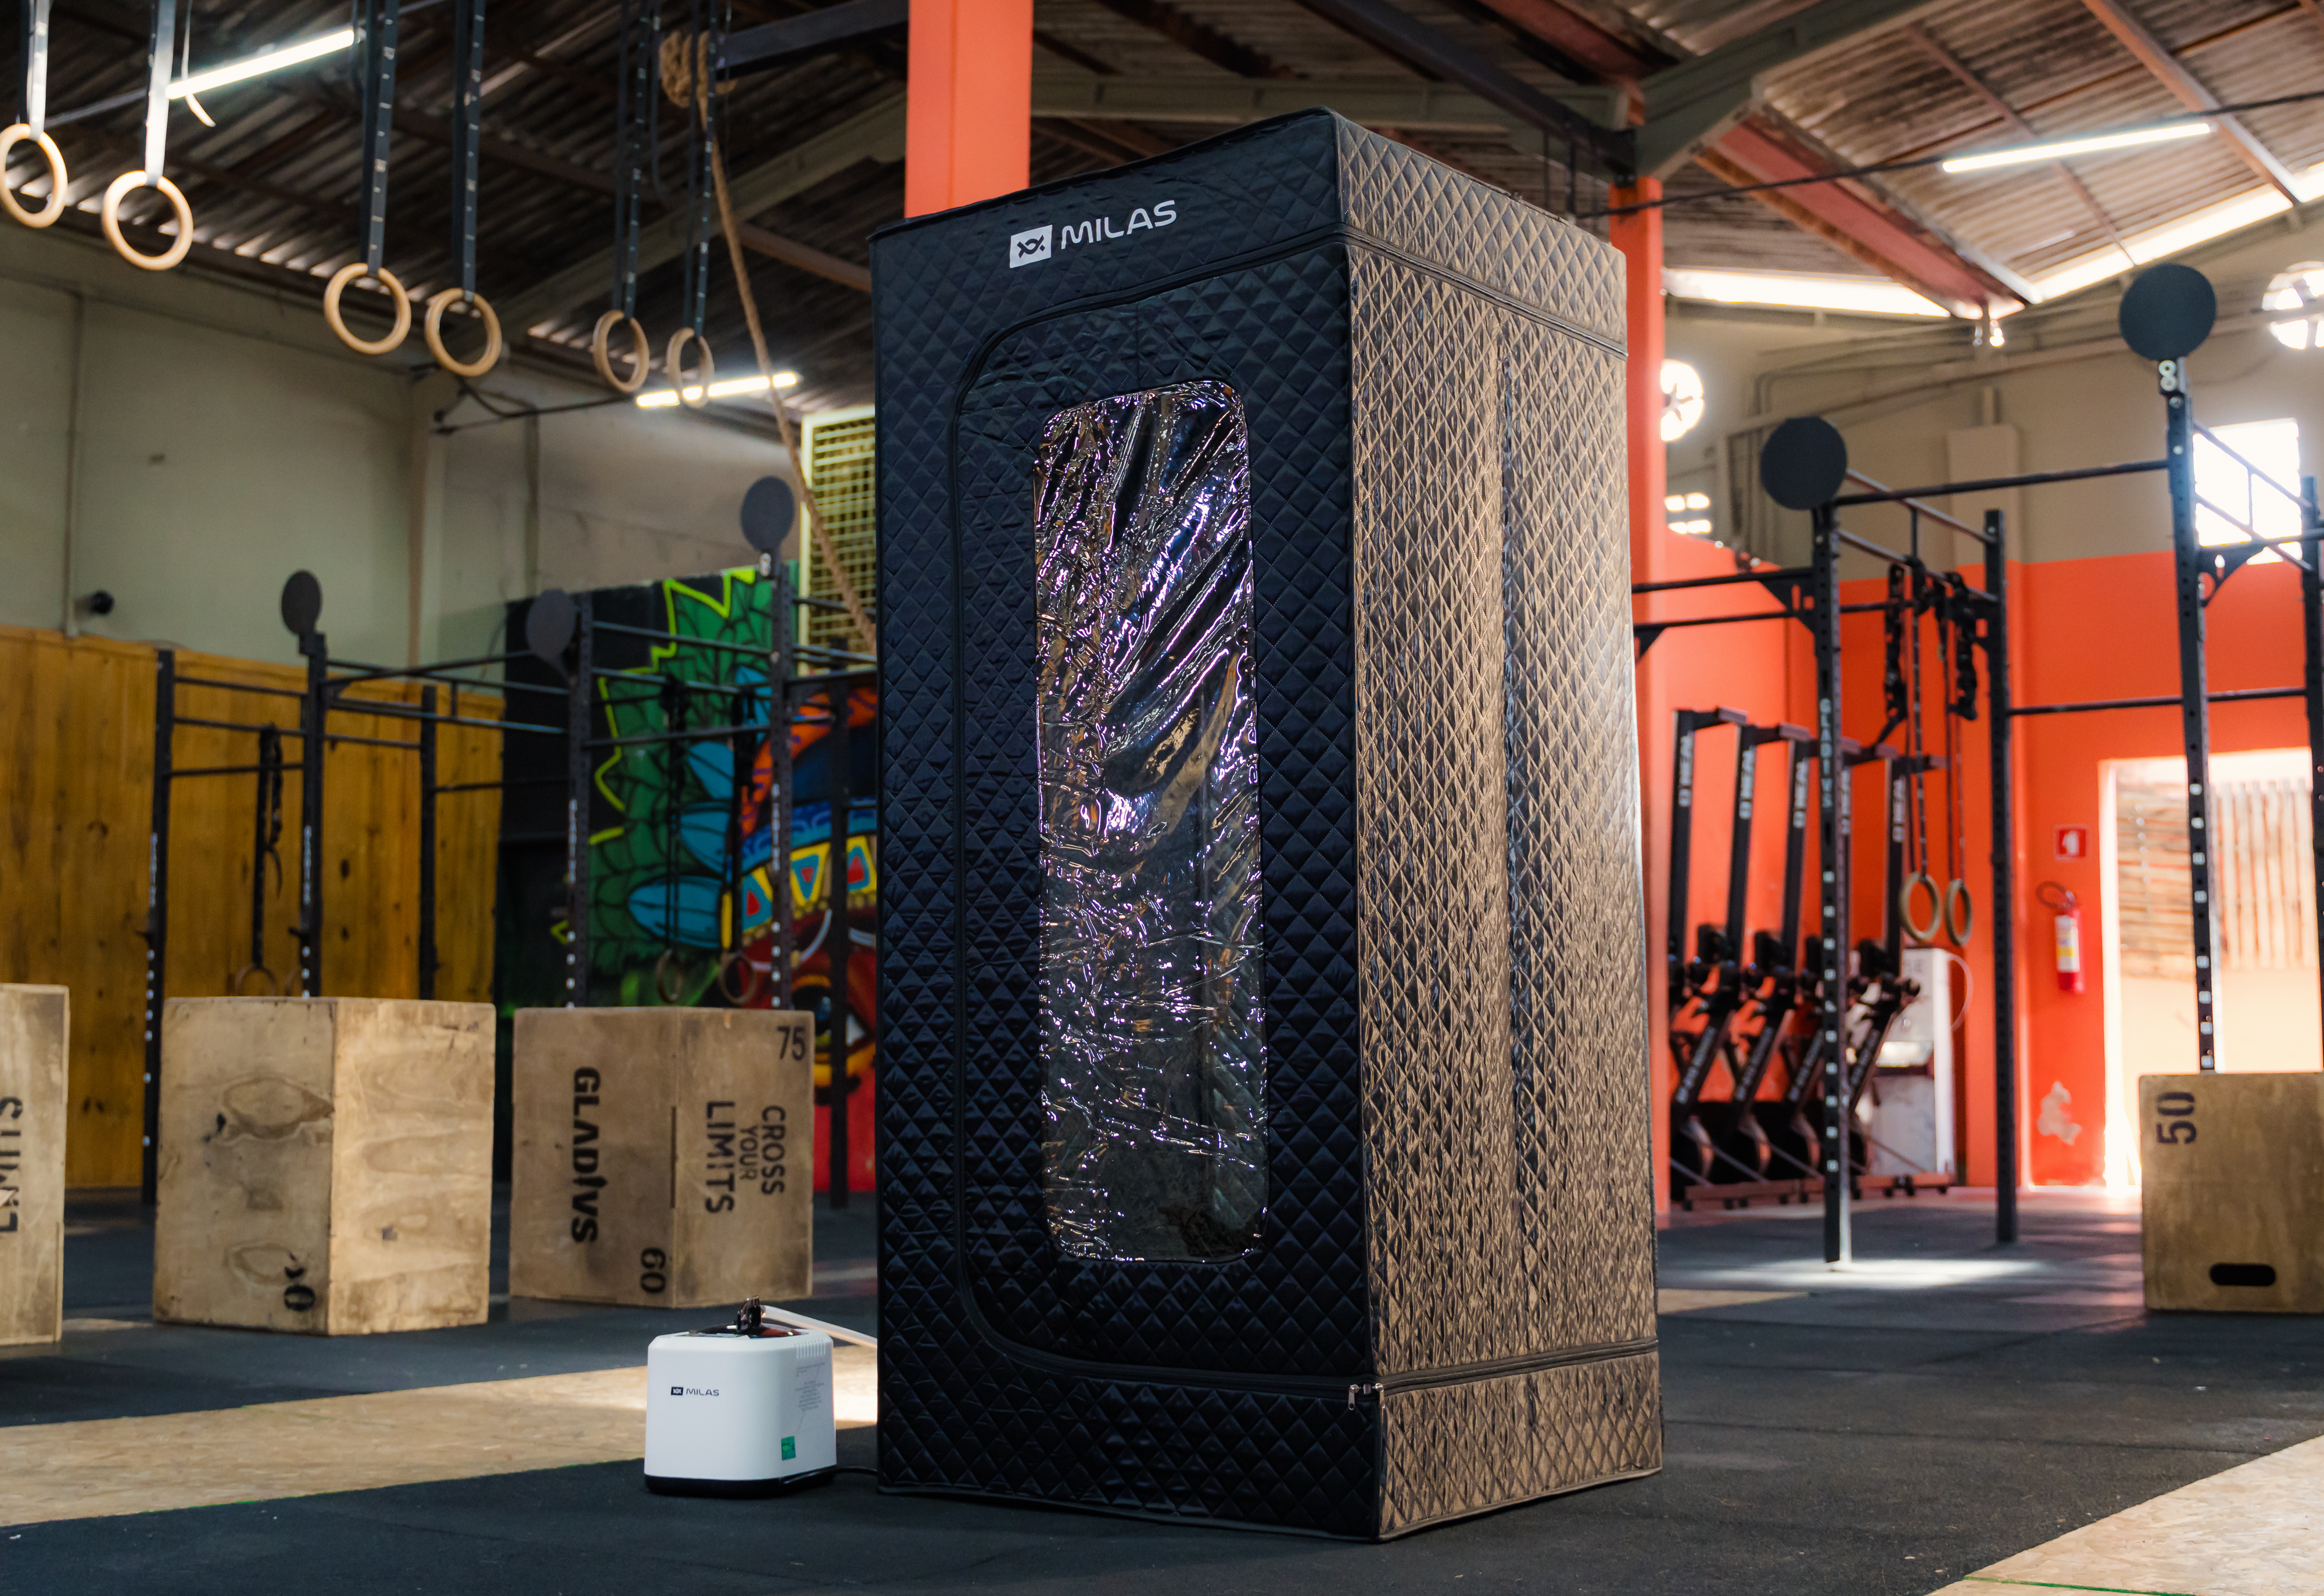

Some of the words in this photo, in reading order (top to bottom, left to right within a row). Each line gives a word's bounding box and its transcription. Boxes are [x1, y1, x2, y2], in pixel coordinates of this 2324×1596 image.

[1061, 200, 1177, 249] MILAS
[777, 1026, 806, 1061] 75
[2156, 1092, 2197, 1145] 50
[571, 1066, 608, 1244] GLADIVS
[706, 1100, 736, 1213] LIMITS
[740, 1125, 758, 1181] YOUR
[762, 1105, 786, 1196] CROSS
[641, 1247, 666, 1294] 60
[686, 1388, 719, 1396] MILAS
